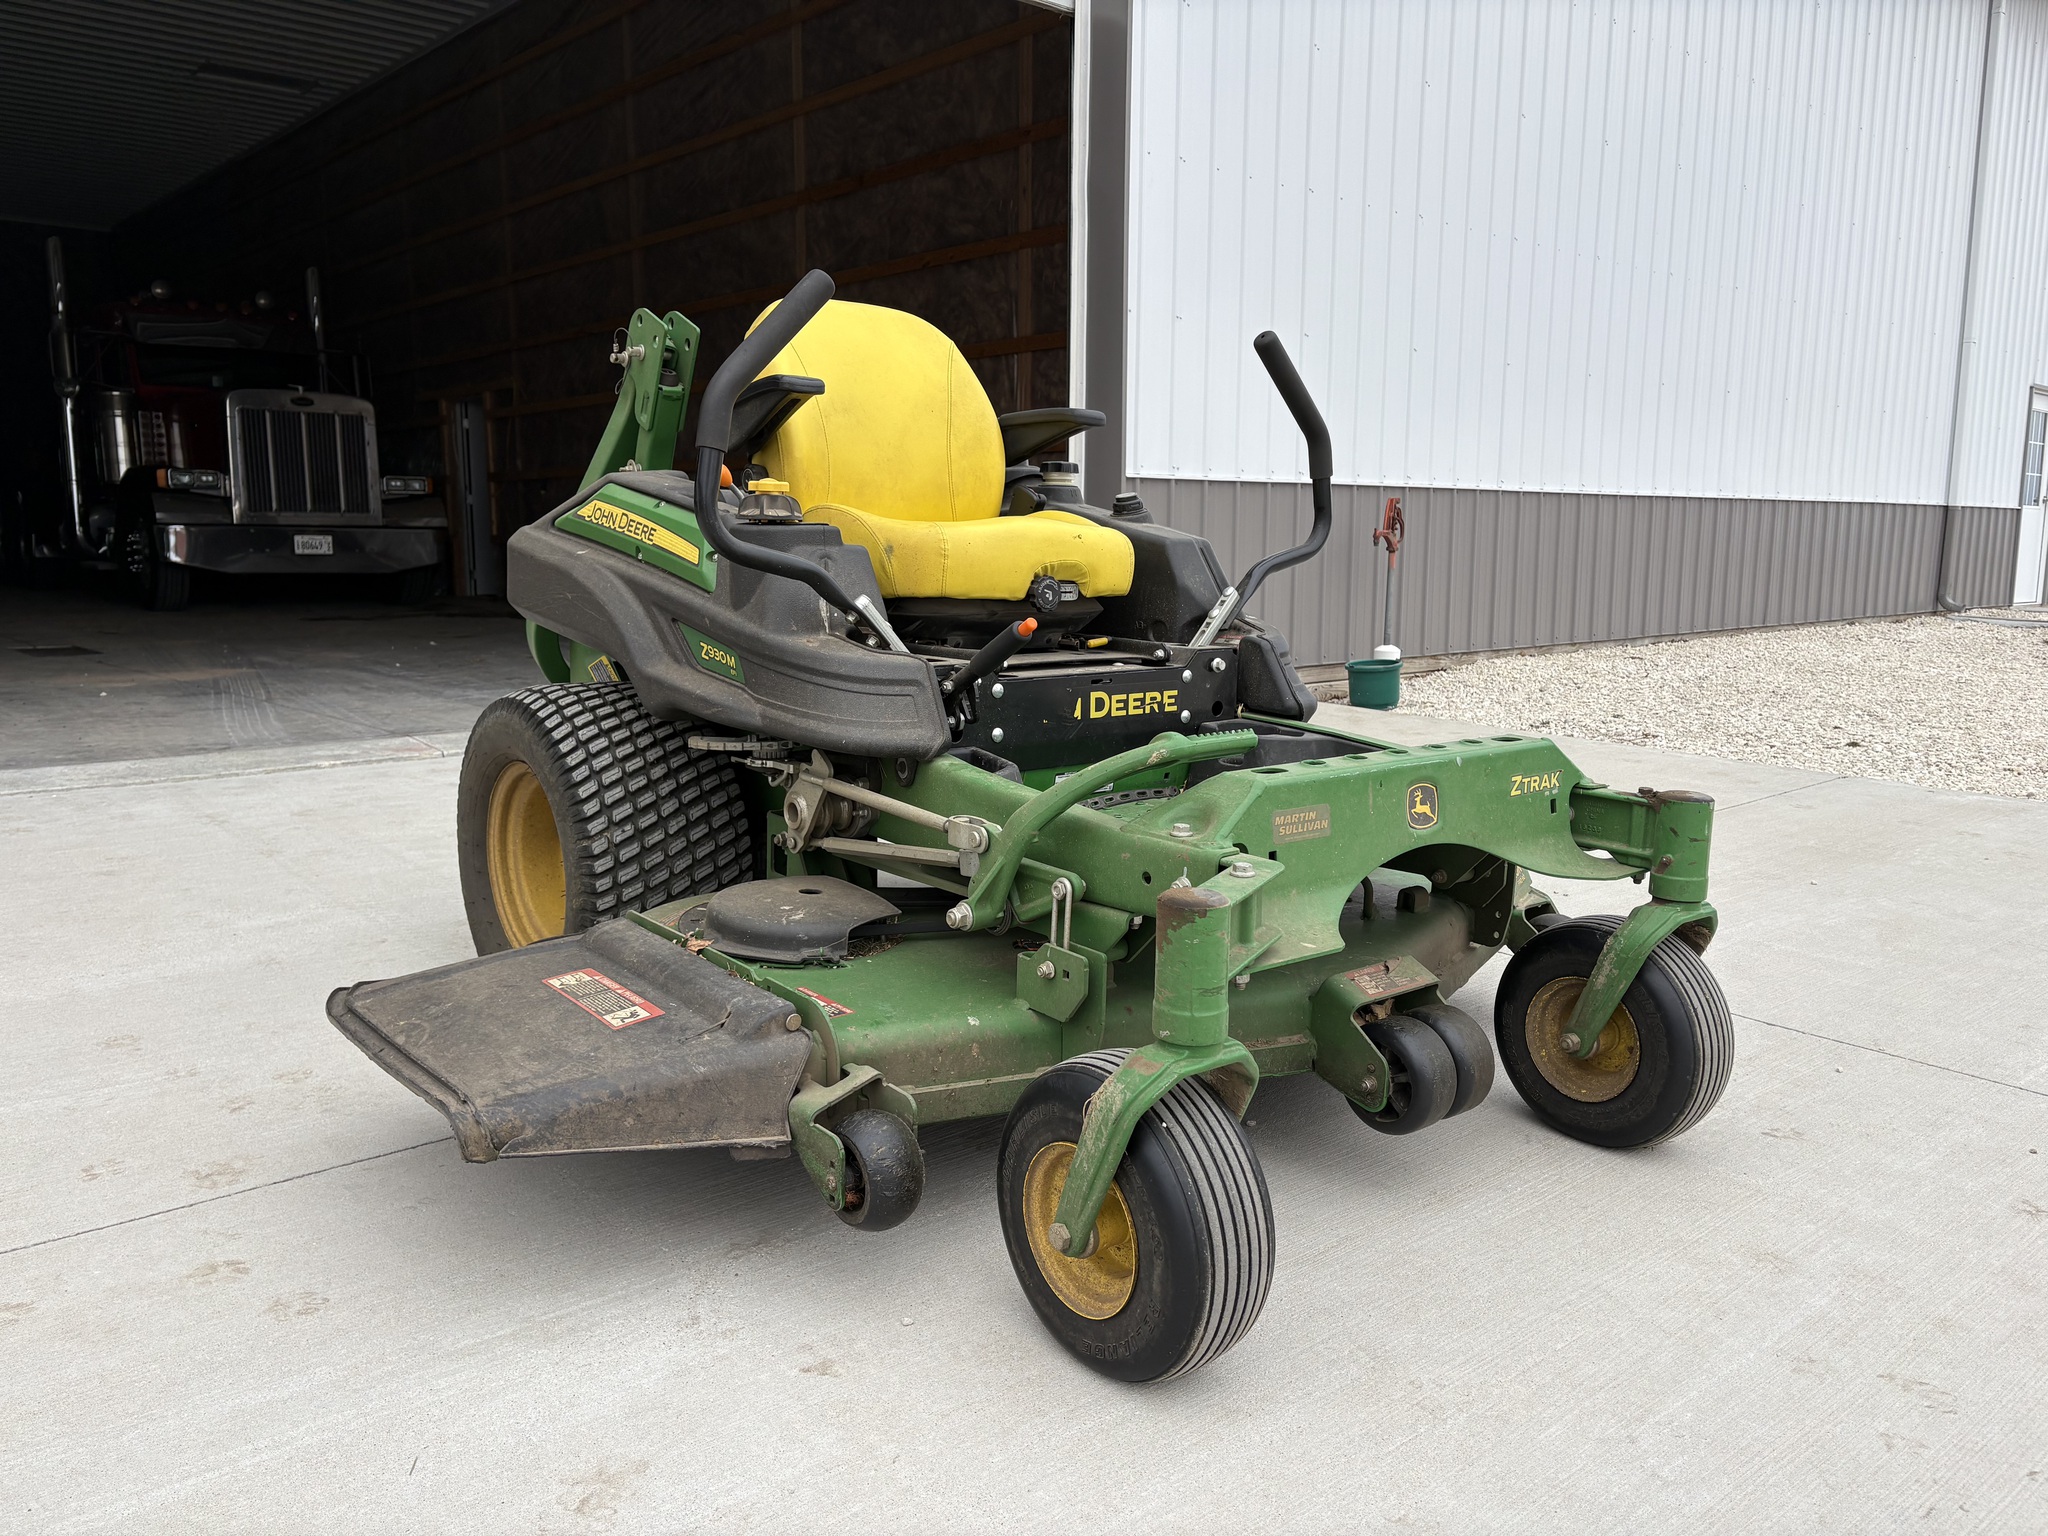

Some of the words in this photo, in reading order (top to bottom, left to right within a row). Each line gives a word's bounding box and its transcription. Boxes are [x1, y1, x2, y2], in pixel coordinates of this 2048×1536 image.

[587, 503, 618, 527] JOHN
[618, 512, 657, 542] DEERE
[699, 641, 736, 669] Z930M
[1090, 690, 1179, 719] DEERE
[1275, 811, 1317, 826] MARTIN
[1279, 819, 1329, 836] SULLIVAN
